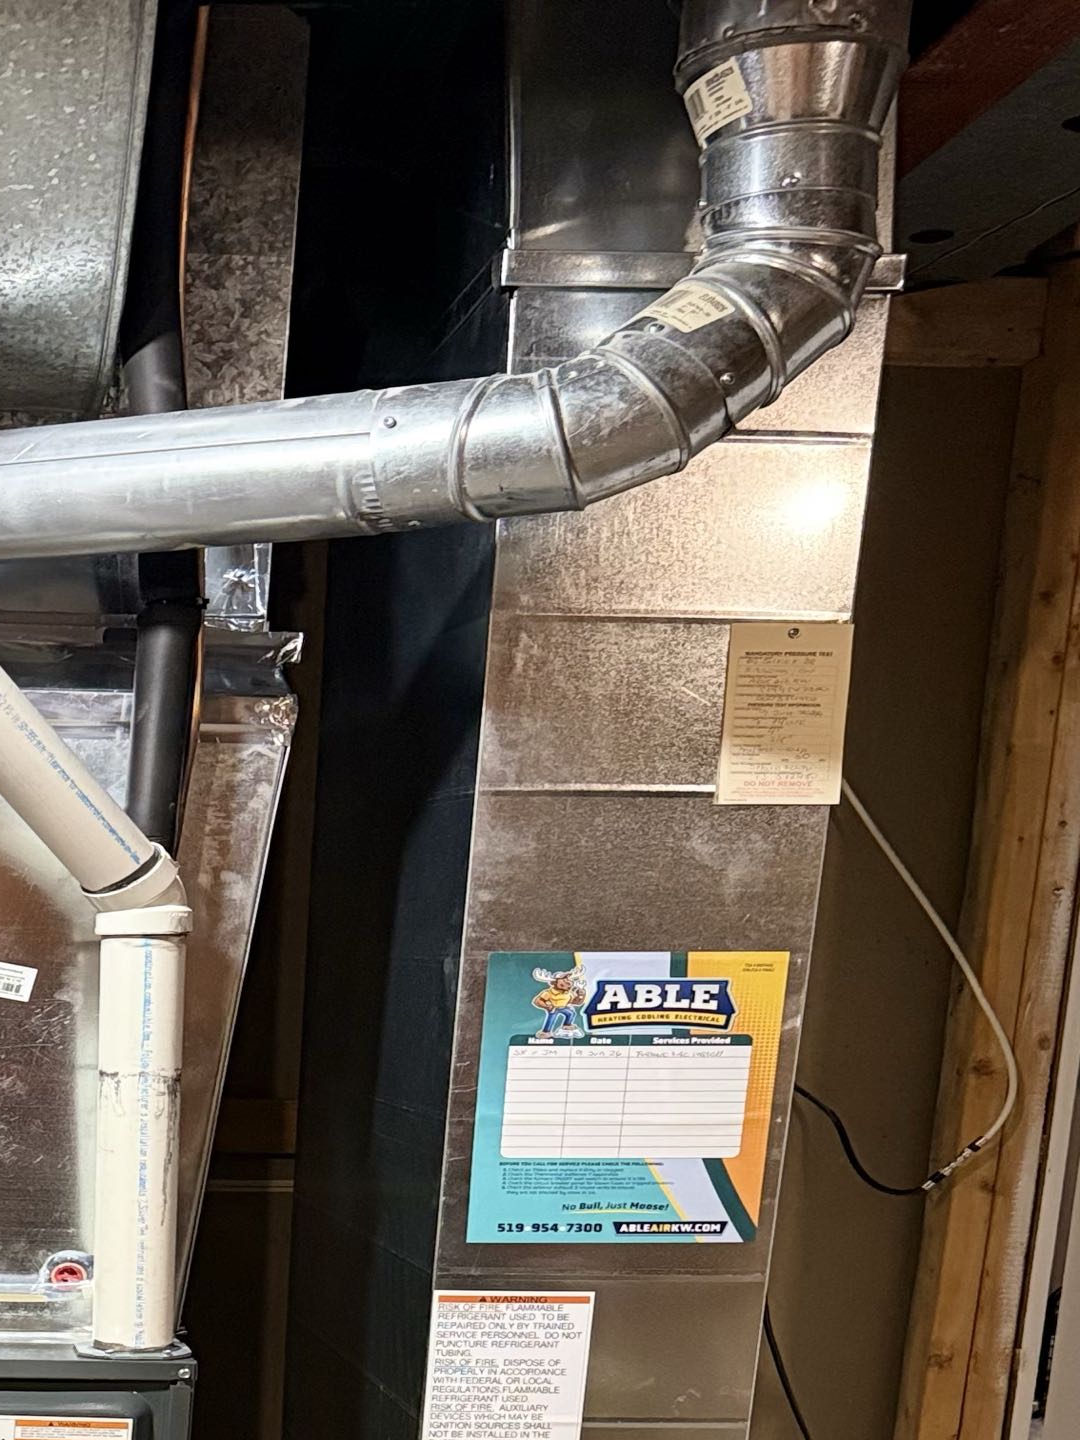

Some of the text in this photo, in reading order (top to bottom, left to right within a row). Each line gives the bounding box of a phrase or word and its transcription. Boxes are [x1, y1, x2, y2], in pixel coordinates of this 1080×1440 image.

[596, 984, 722, 1011] ABLE
[597, 1015, 632, 1023] HEATING
[674, 1014, 721, 1023] ELECTRICAL
[527, 1036, 731, 1045] Name Date Services Provided
[562, 1202, 669, 1211] No Bull, Just Moose!
[619, 1223, 722, 1233] ABLEAIRKW.COM
[438, 1313, 570, 1321] REFRIGERANT TO BE
[437, 1322, 574, 1330] REPAIRED ONLY BY TRAINED
[436, 1331, 582, 1339] SERVICE DO NOT
[436, 1340, 560, 1348] PUNCTURE REFRIGERANT
[436, 1349, 472, 1357] TUBING.
[434, 1368, 566, 1376] PROPERLY IN ACCORDANCE
